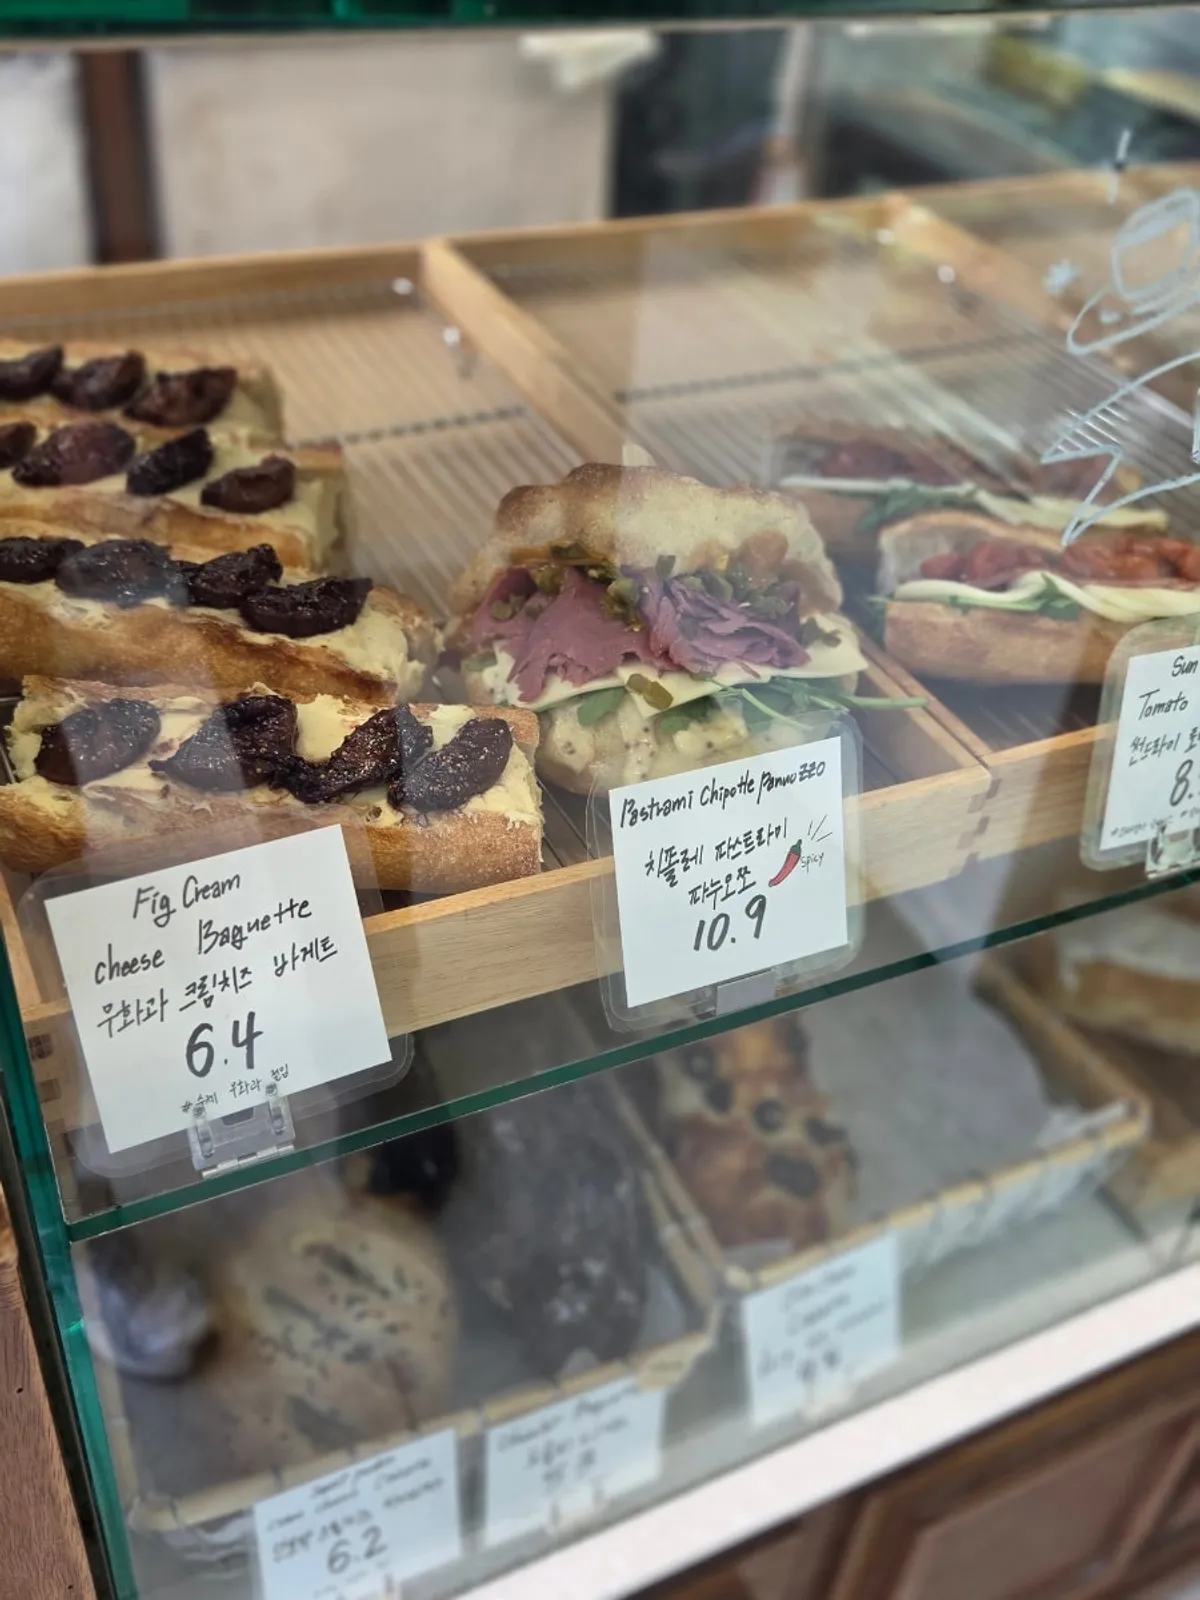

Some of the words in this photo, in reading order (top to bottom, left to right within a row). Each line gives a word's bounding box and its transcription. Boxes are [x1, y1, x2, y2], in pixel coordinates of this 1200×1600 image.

[1171, 655, 1199, 677] Sun
[1138, 689, 1189, 720] Tomato
[1169, 758, 1200, 807] 8.
[620, 790, 694, 828] Pastrami
[714, 817, 788, 860] 파스트라미
[132, 885, 176, 929] Fig
[182, 873, 241, 909] Cream
[687, 865, 757, 911] 파누오쪼
[197, 898, 313, 956] Baguette
[693, 894, 767, 952] 10.9
[96, 987, 169, 1039] 무화과
[178, 965, 253, 1009] 크림치즈
[273, 935, 338, 978] 바게트
[185, 1011, 264, 1079] 6.4
